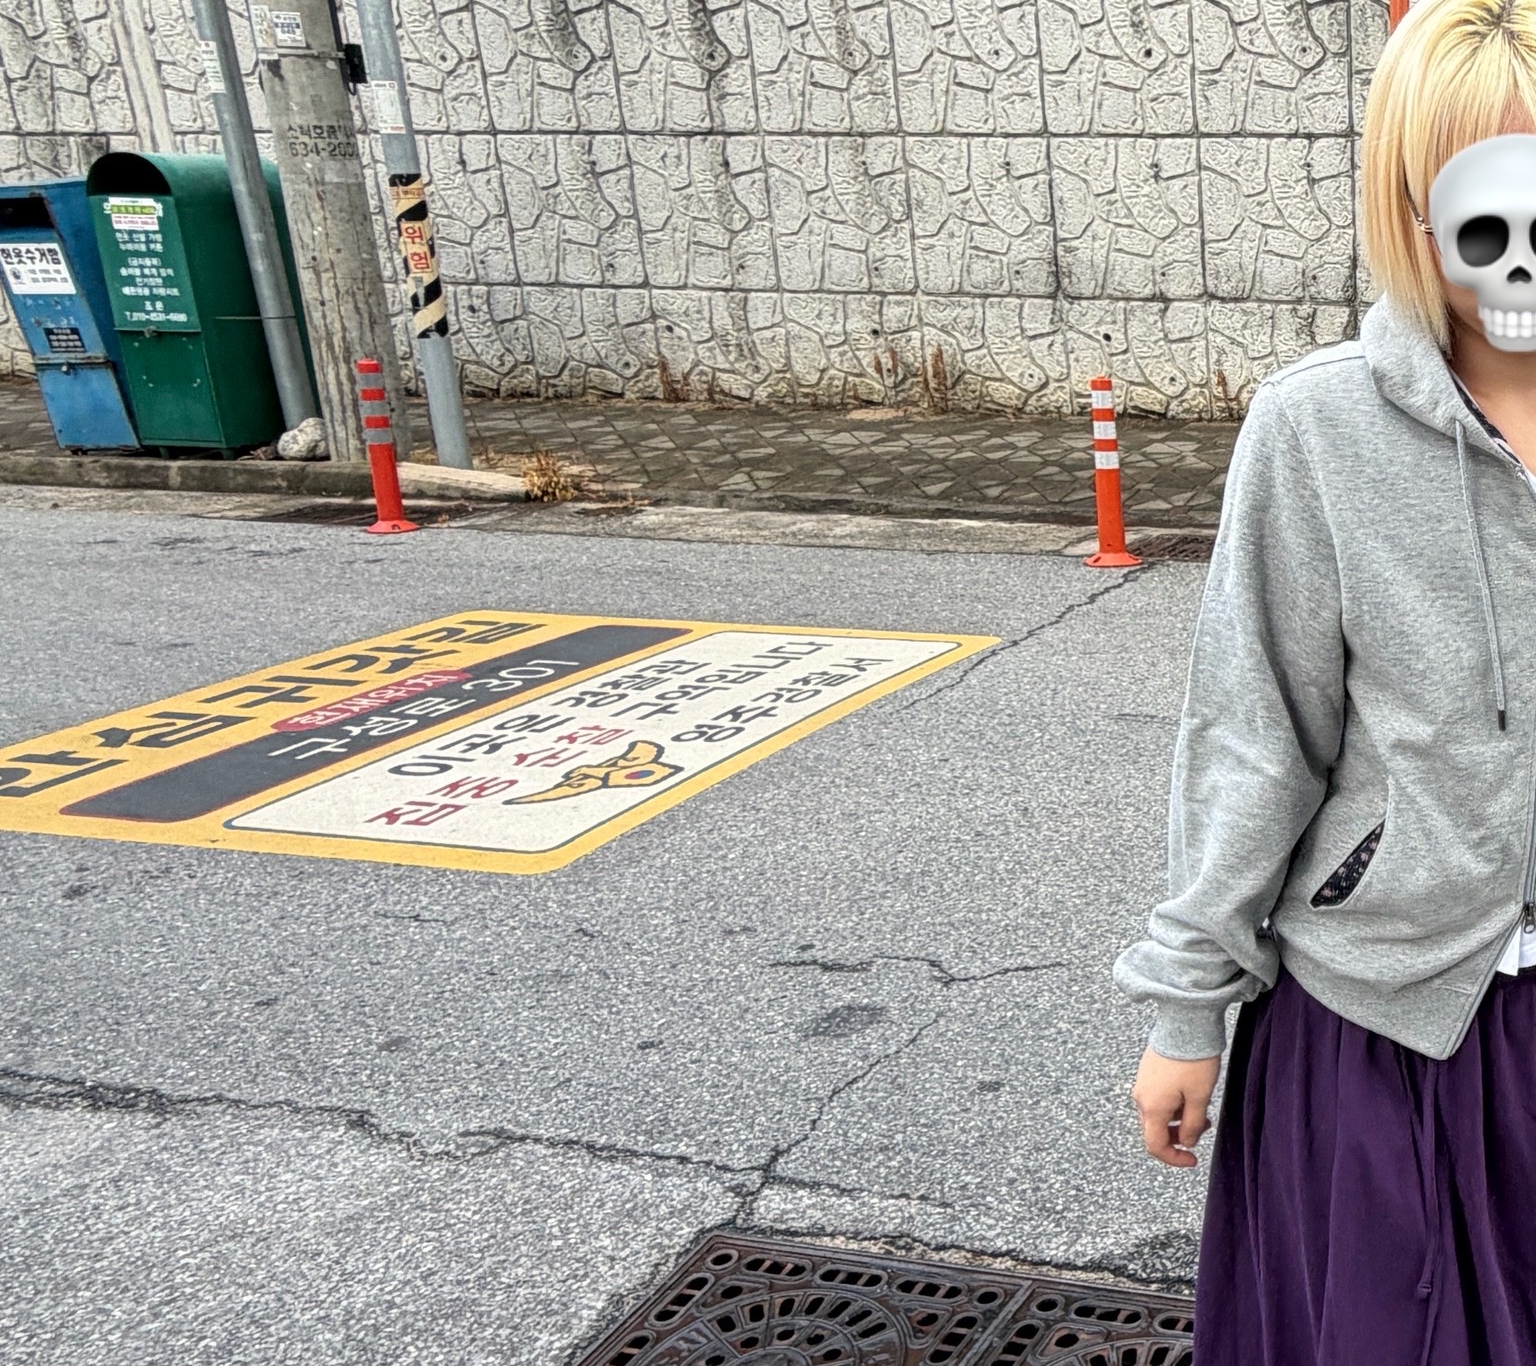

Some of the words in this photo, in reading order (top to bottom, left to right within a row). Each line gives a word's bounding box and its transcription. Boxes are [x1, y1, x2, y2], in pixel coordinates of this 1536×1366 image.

[0, 247, 62, 265] 헌옷수거함
[405, 226, 430, 270] 위험
[0, 620, 547, 797] 안심귀갓길
[268, 698, 476, 760] 구성로
[462, 659, 579, 693] 301
[288, 673, 461, 725] 현재위치
[364, 776, 517, 826] 집중
[511, 724, 634, 768] 순찰
[609, 641, 834, 720] 구역입니다
[387, 714, 576, 777] 이곳은
[551, 659, 709, 708] 경찰관
[671, 656, 893, 744] 영주경찰서
